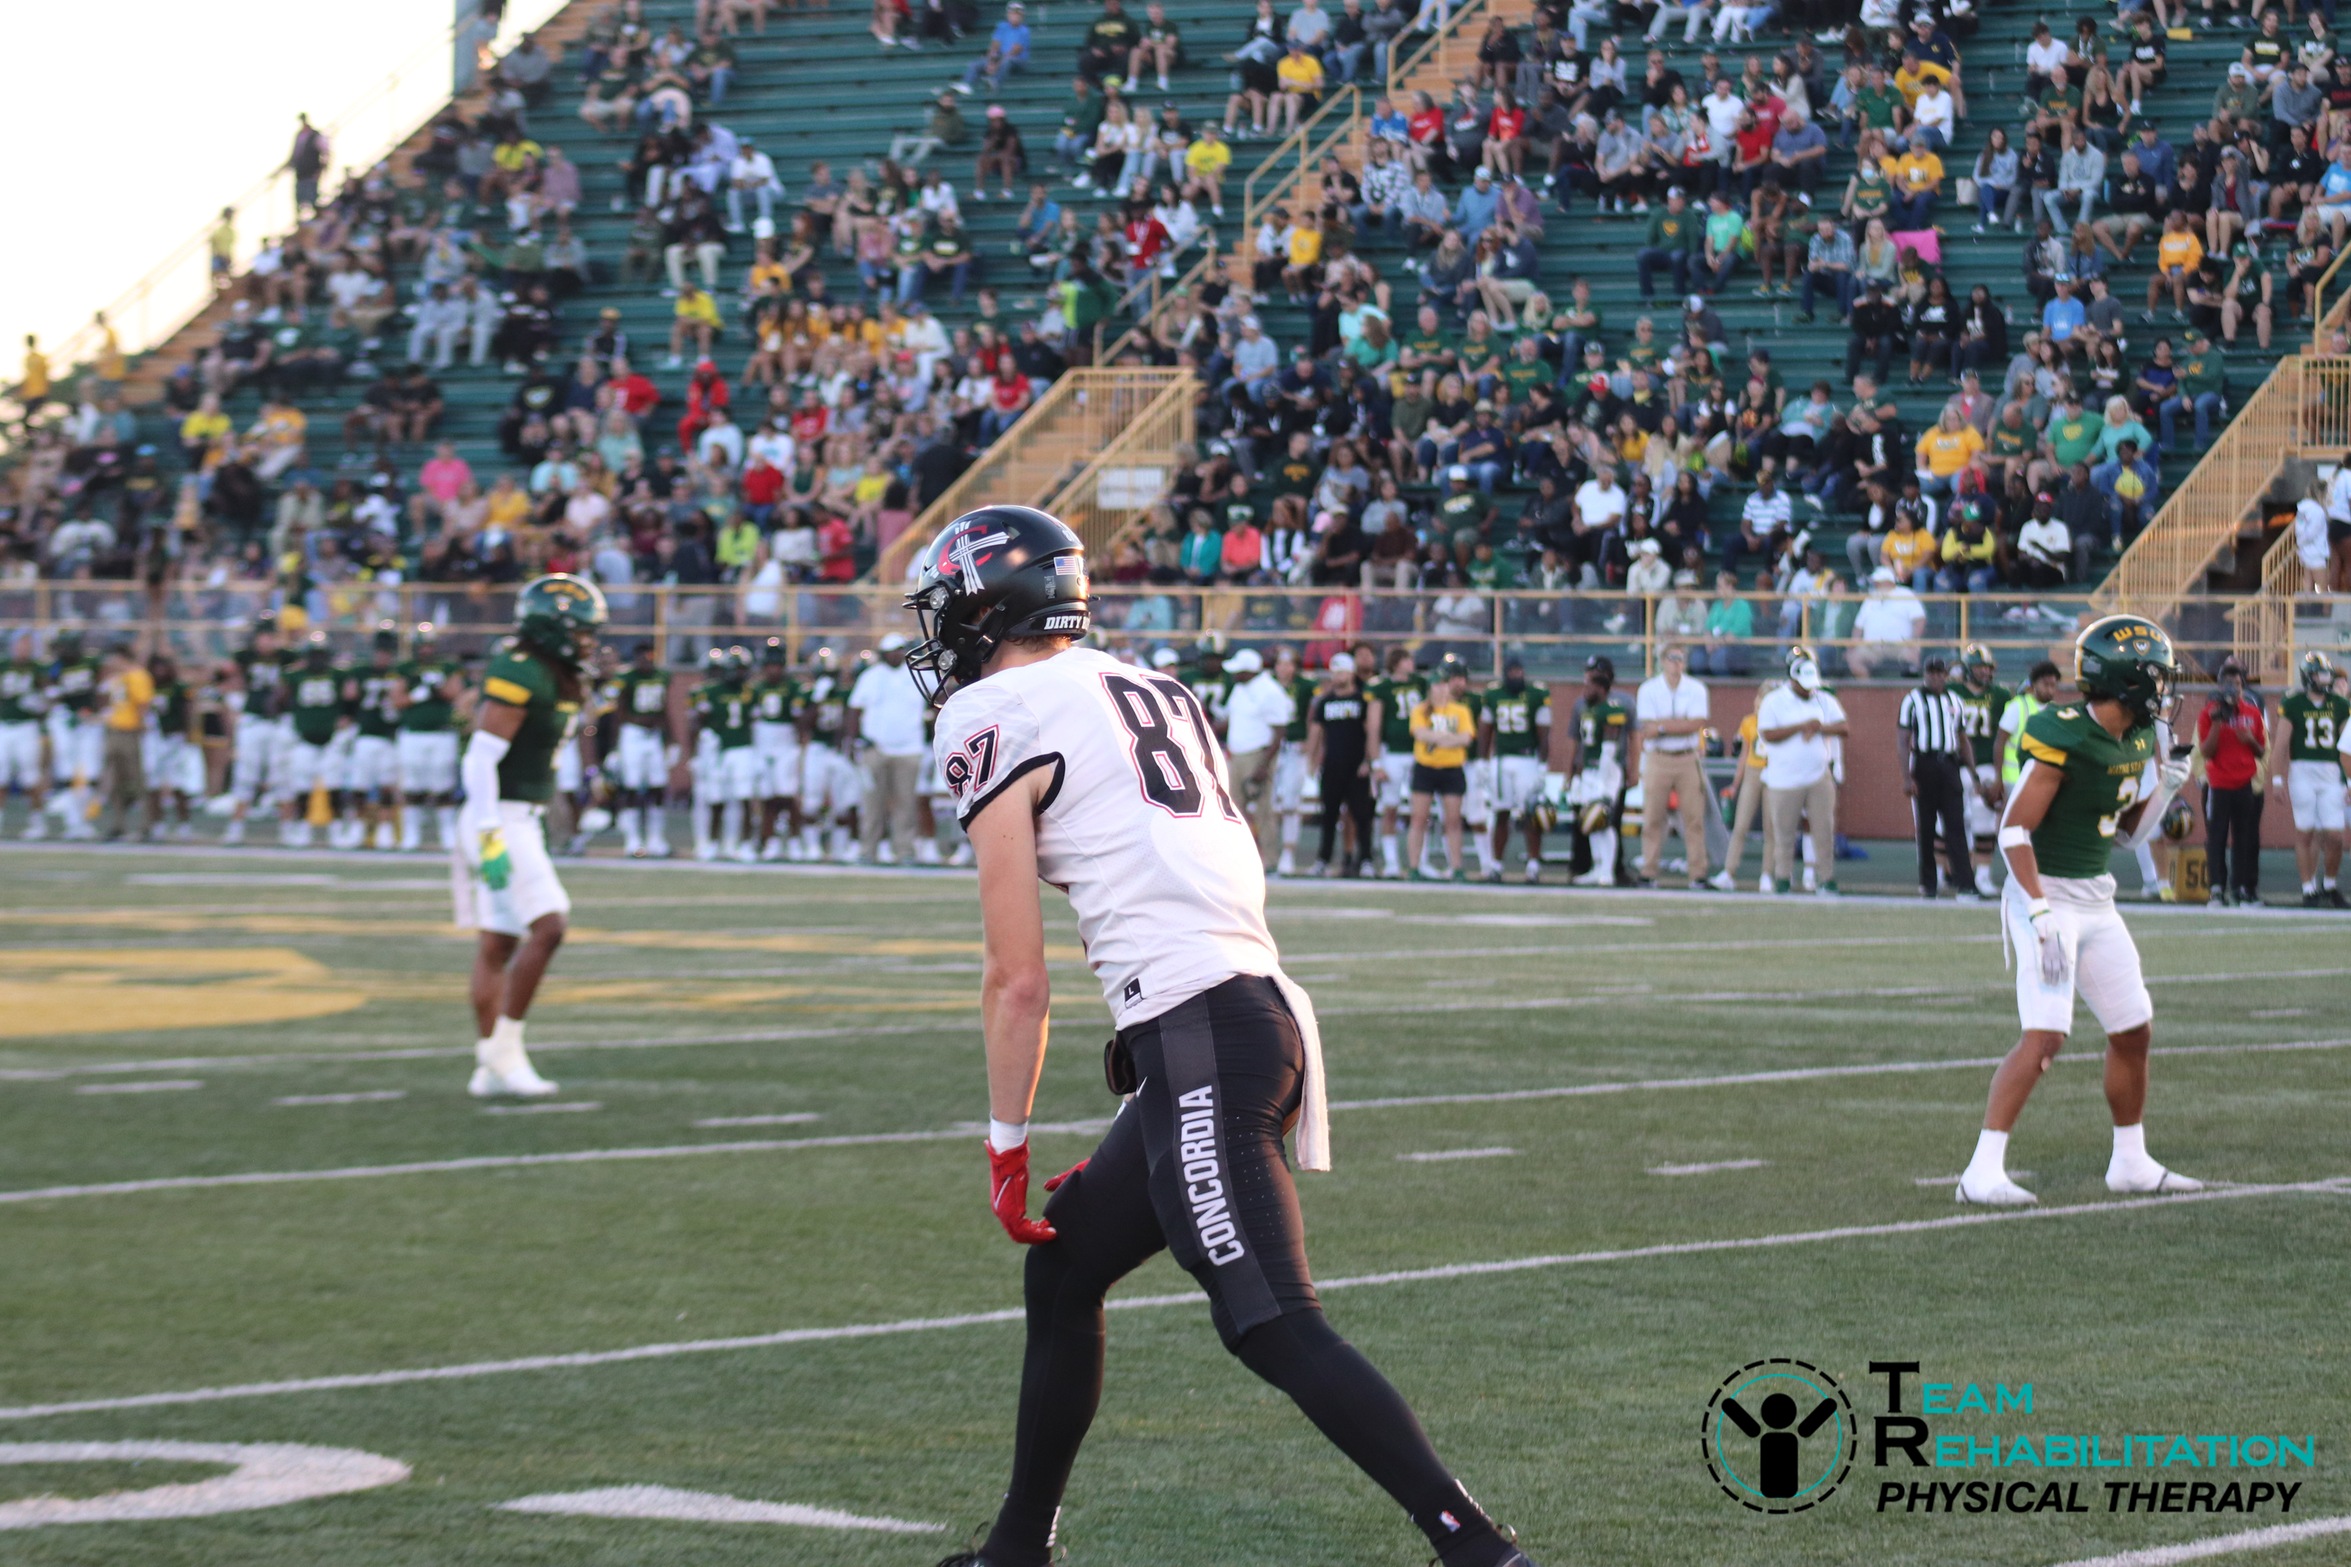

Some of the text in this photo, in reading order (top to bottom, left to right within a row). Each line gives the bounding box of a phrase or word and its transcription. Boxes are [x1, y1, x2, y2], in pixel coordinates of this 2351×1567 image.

[1044, 615, 1082, 630] DIRTY
[2113, 625, 2163, 643] WSU
[1496, 704, 1528, 734] 25
[1964, 705, 1991, 737] 71
[2304, 716, 2334, 749] 13
[944, 724, 999, 801] 87
[1098, 672, 1242, 825] 87
[2097, 776, 2139, 837] 3
[1178, 1085, 1246, 1267] CONCORDIA
